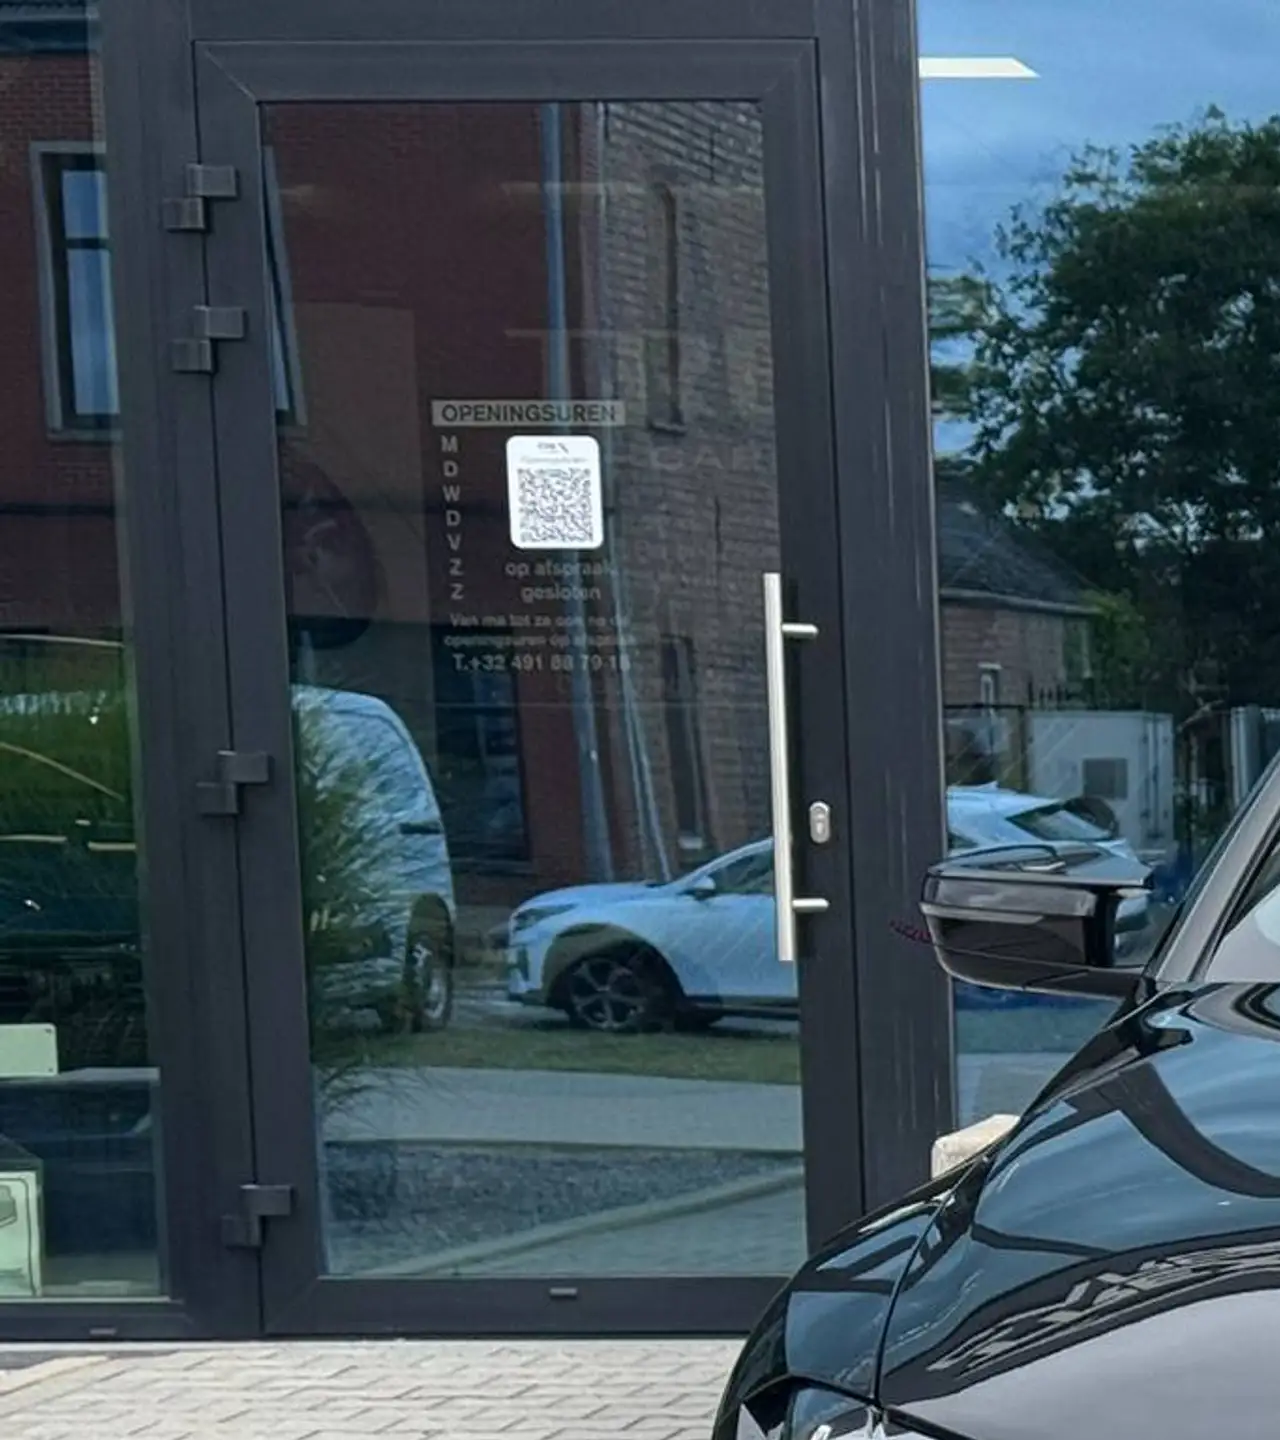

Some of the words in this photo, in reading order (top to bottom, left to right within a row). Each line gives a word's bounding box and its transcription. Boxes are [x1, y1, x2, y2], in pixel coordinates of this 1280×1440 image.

[441, 404, 617, 422] OPENINGSUREN
[441, 435, 458, 453] M
[444, 461, 458, 477] D
[443, 485, 461, 502] W
[446, 510, 461, 526] D
[447, 532, 461, 550] V
[449, 559, 464, 576] Z
[450, 583, 465, 600] Z
